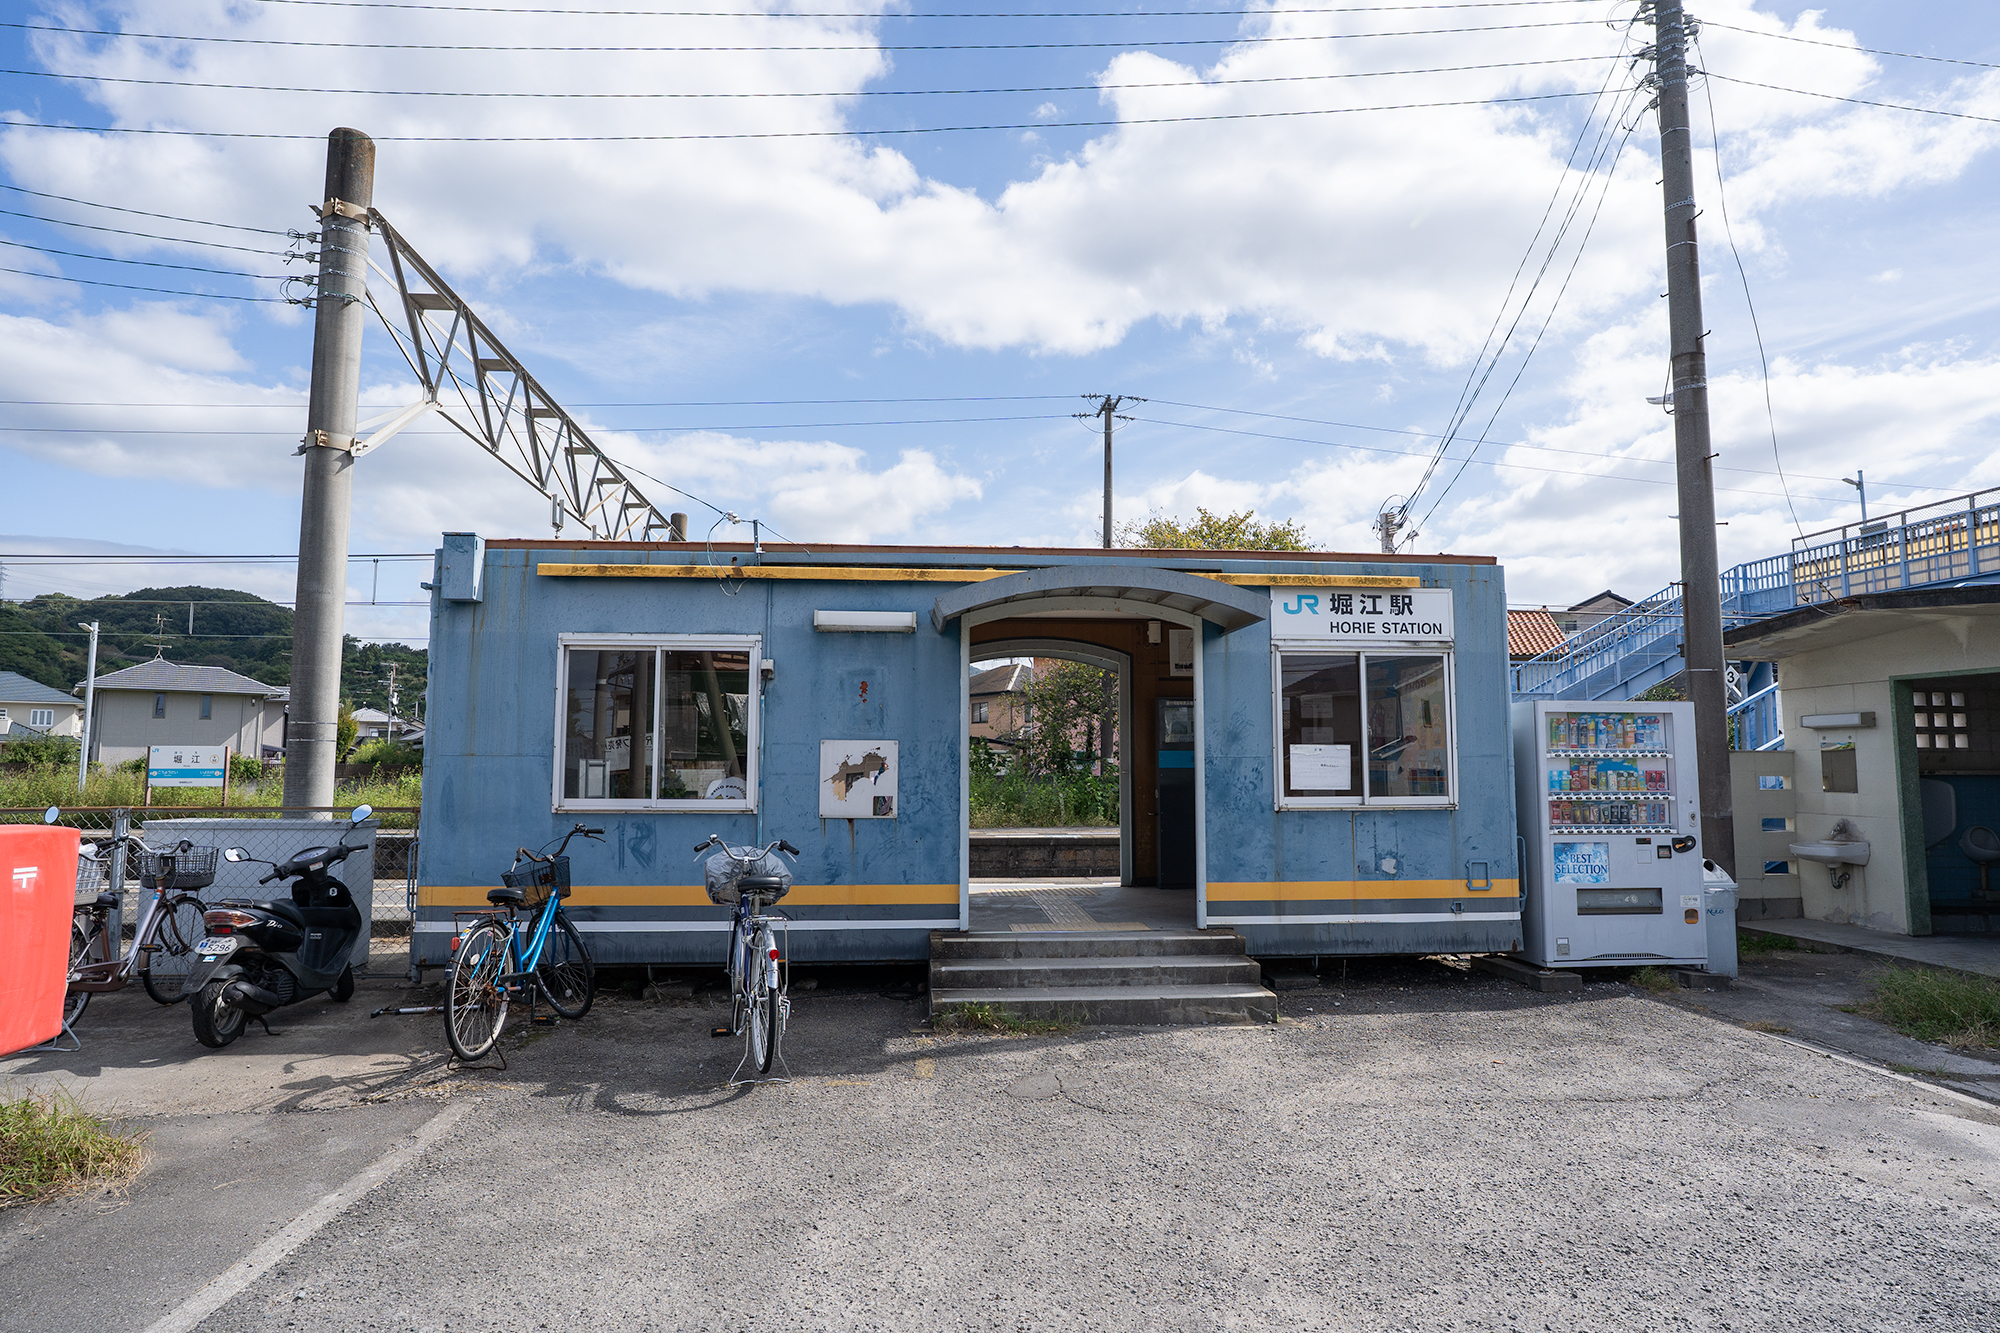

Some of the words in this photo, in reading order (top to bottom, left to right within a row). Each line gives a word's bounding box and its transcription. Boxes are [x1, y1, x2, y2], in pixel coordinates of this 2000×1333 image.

[1283, 594, 1320, 615] JR
[1329, 593, 1414, 616] 堀江駅
[1330, 621, 1376, 634] HORIE
[1382, 622, 1442, 635] STATION
[1726, 671, 1735, 683] 3
[173, 755, 200, 763] 堀江
[1570, 853, 1593, 864] BEST
[1555, 864, 1608, 875] SELECTION
[266, 919, 283, 929] Dio
[206, 944, 232, 952] 5296
